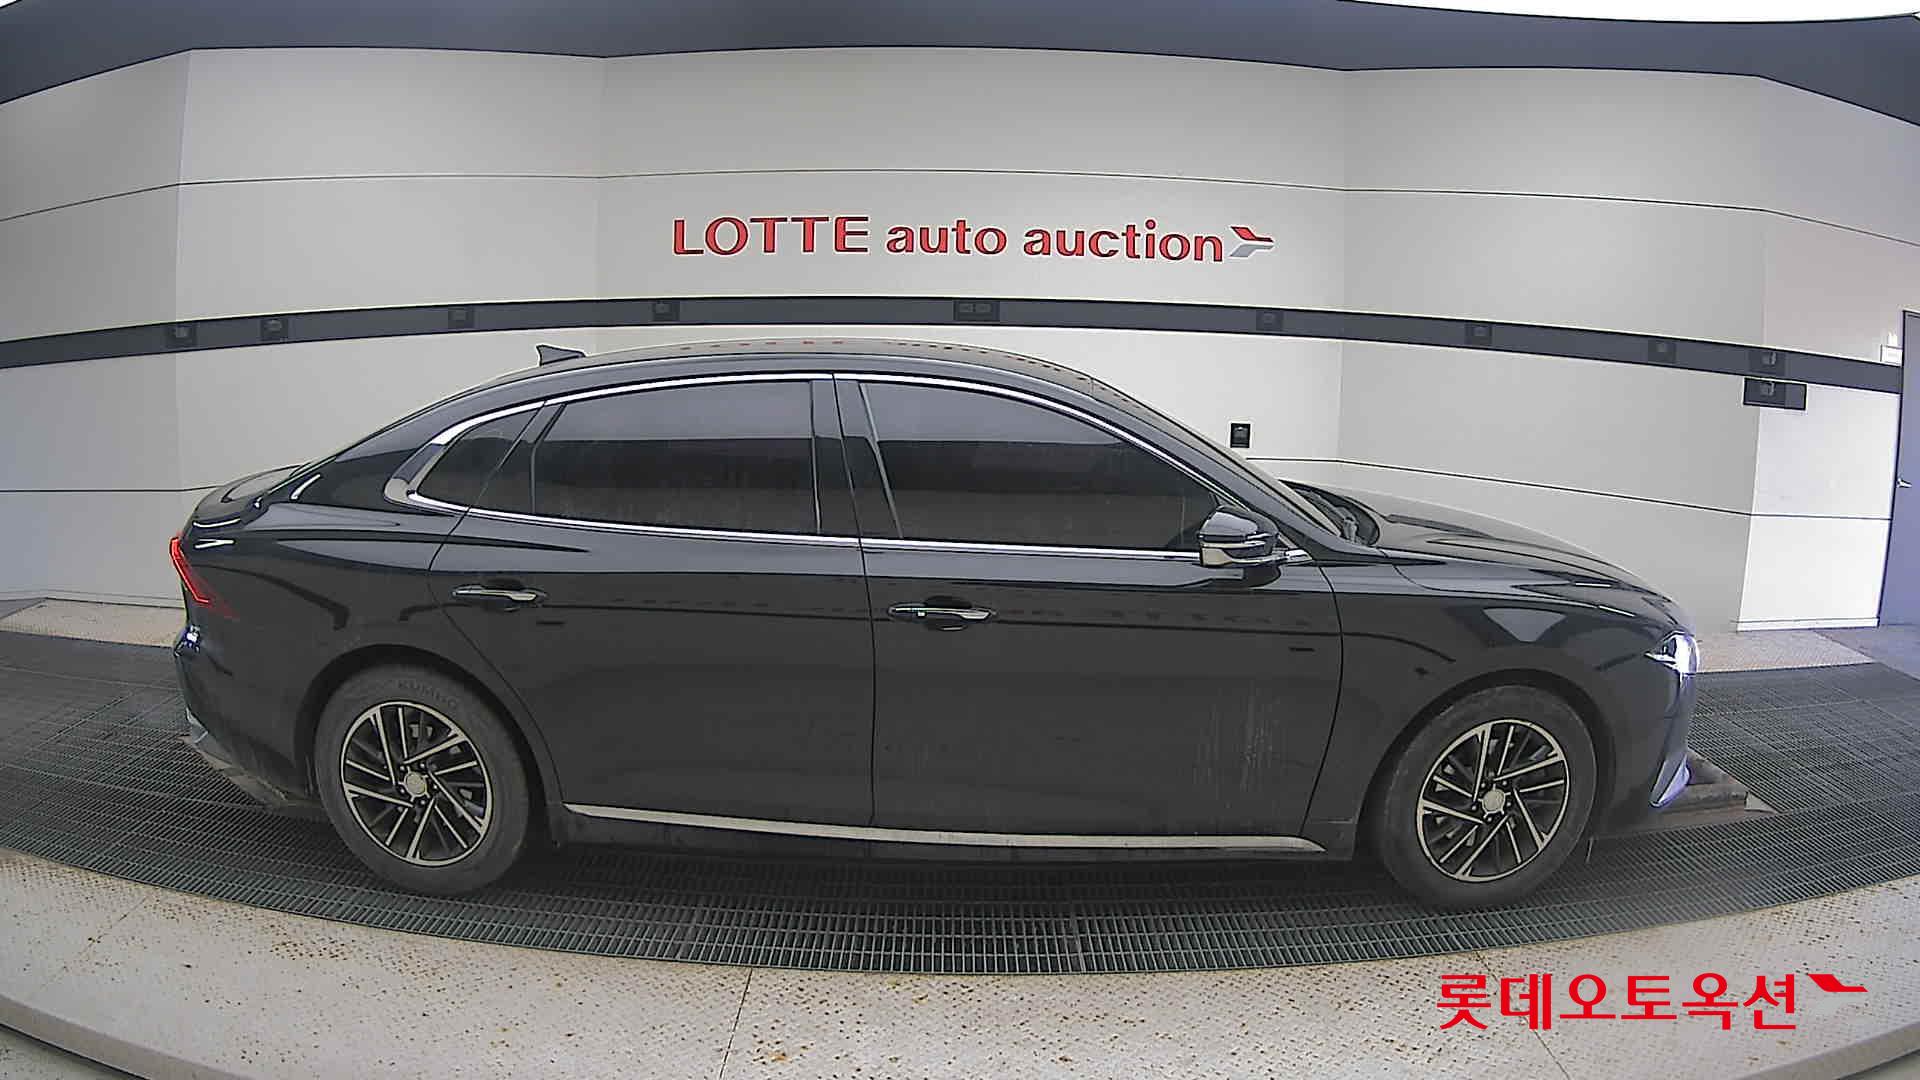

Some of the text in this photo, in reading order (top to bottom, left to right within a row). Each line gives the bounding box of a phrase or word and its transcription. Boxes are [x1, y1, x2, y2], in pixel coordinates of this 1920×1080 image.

[674, 216, 1224, 262] LOTTE auto auction
